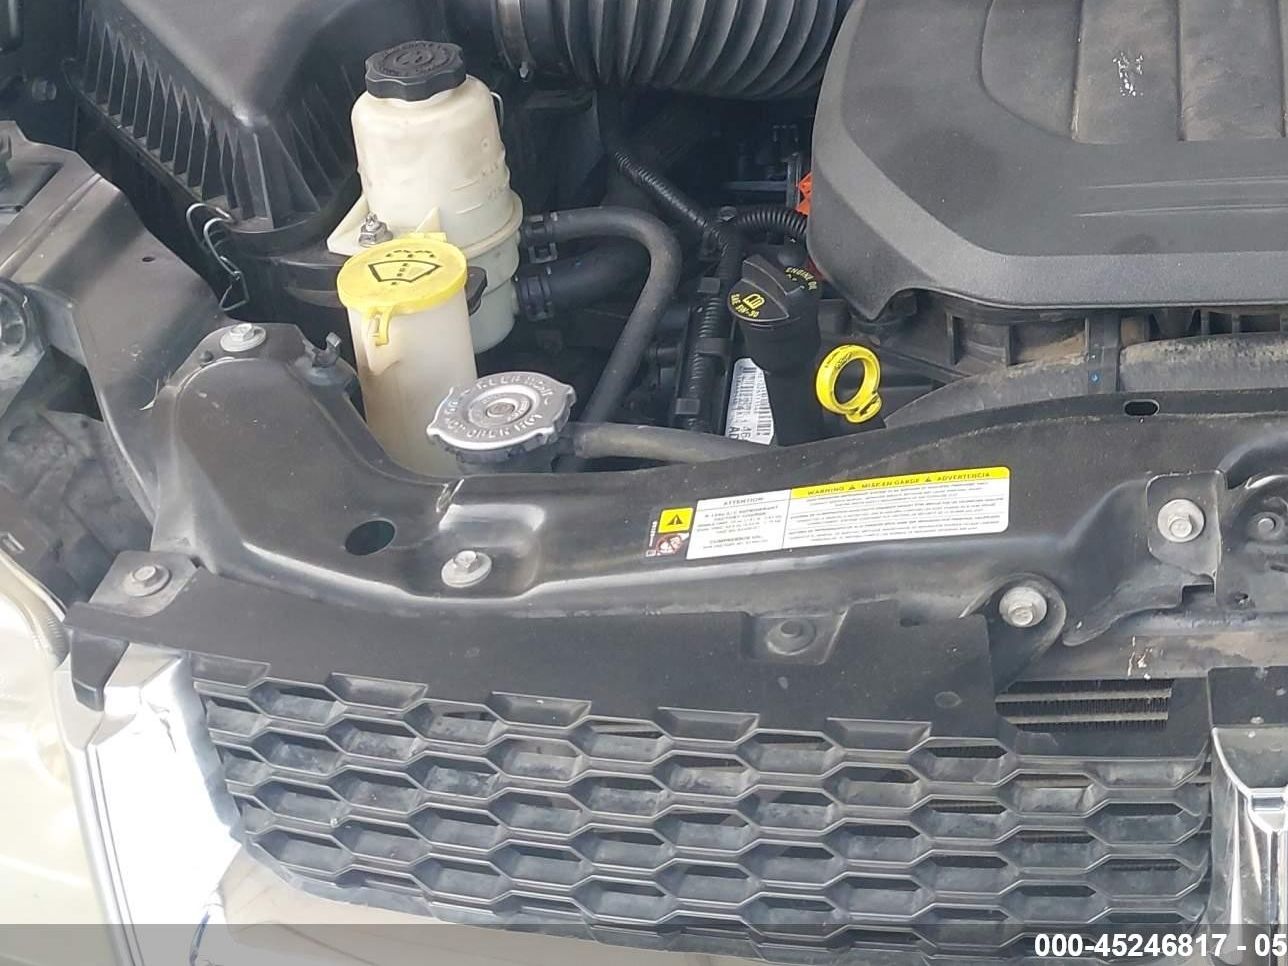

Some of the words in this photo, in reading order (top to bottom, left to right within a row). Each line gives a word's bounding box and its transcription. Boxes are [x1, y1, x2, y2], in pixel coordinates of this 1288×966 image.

[785, 266, 815, 281] ENGINE
[807, 486, 845, 496] WARNING
[937, 472, 990, 481] ADVERTENCIA
[723, 497, 764, 506] ATTENTION
